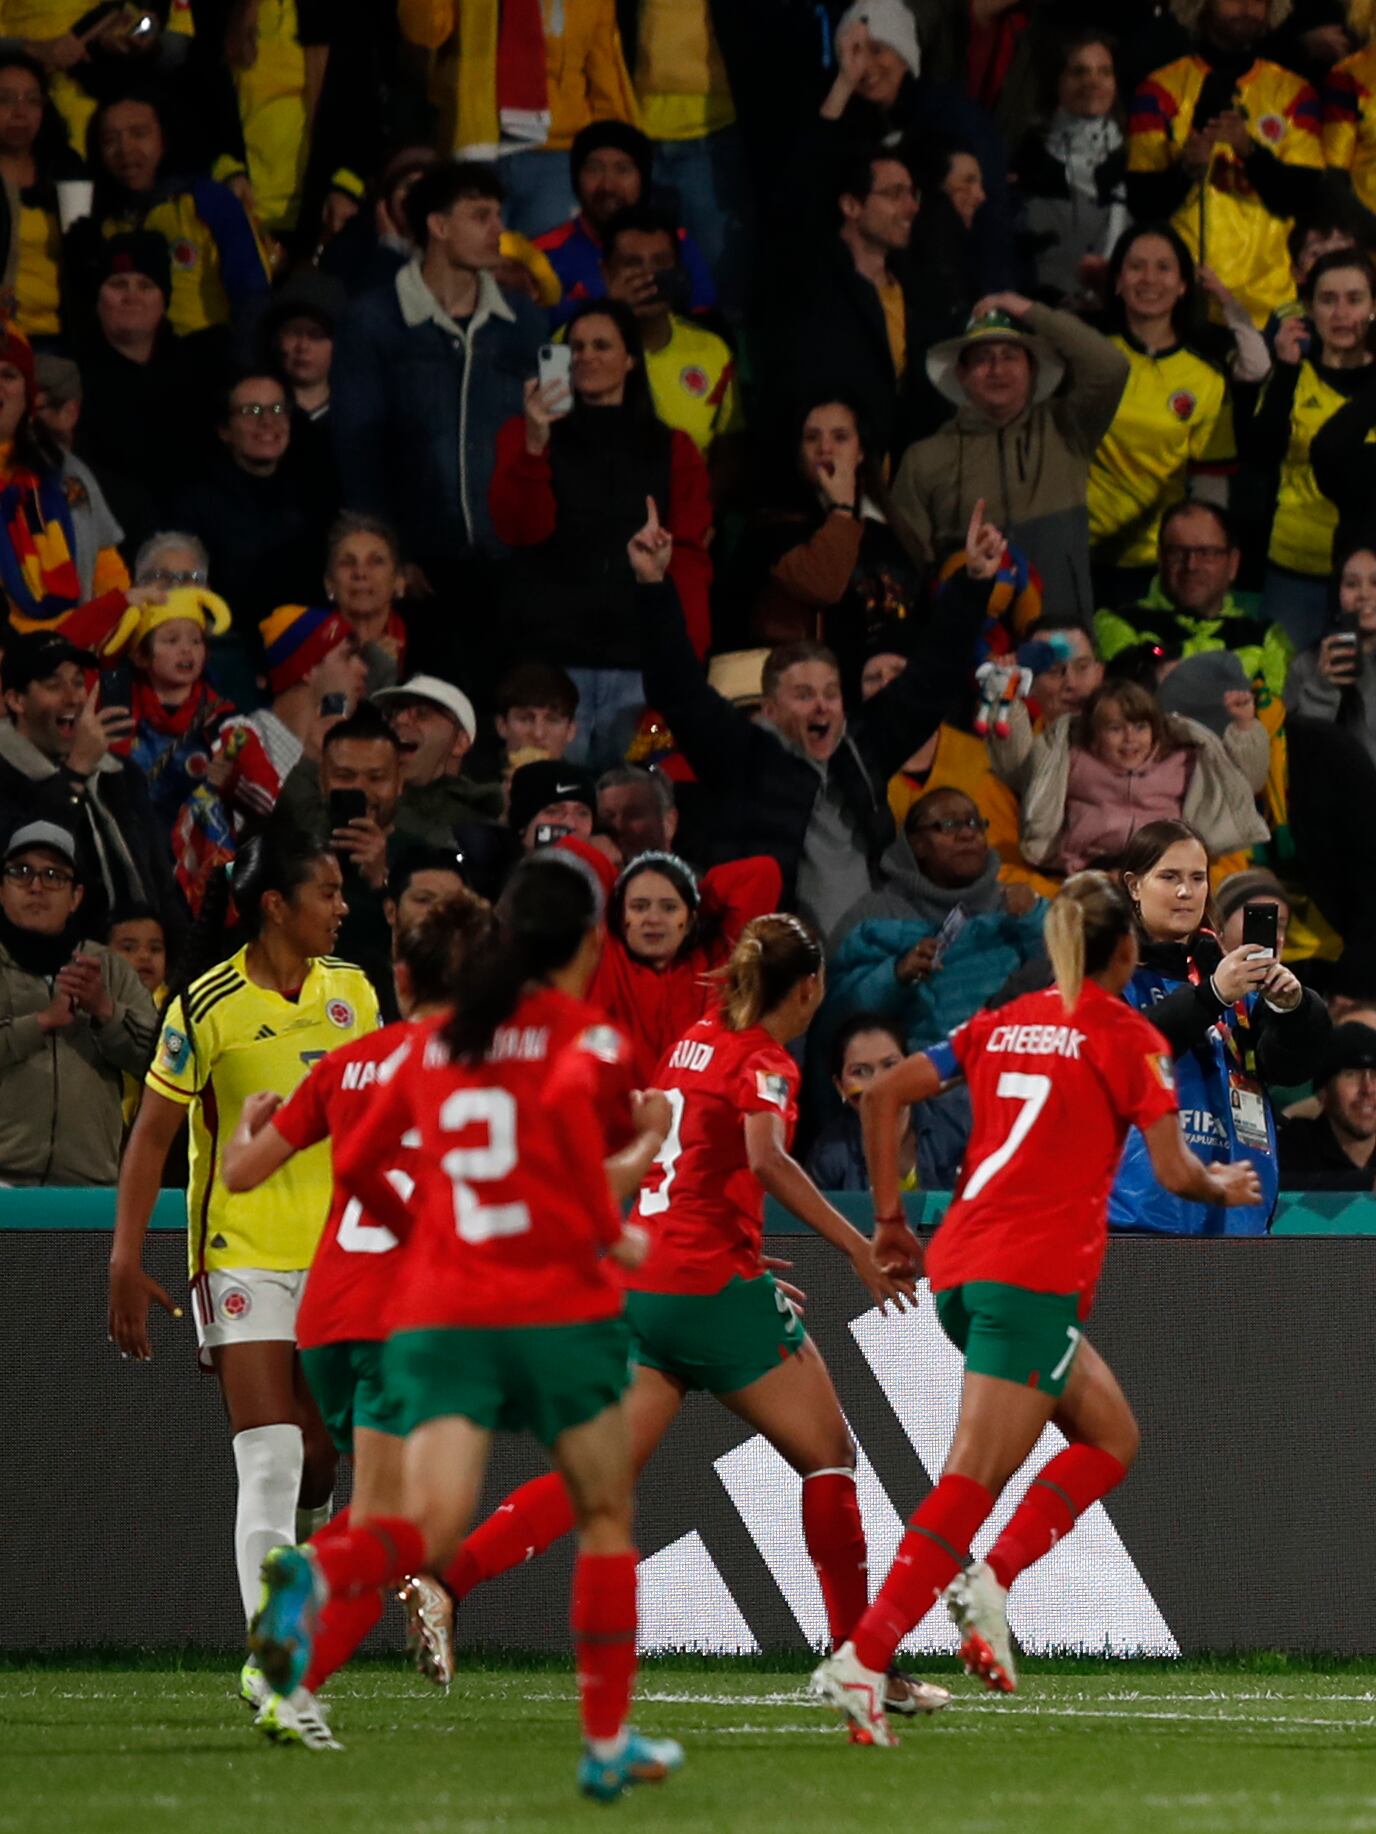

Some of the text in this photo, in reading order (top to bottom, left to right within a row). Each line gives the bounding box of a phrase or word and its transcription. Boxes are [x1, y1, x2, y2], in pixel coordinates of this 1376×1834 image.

[986, 1024, 1088, 1060] CHEEBAK
[961, 1071, 1052, 1201] 7
[1179, 1109, 1228, 1138] FIFA
[440, 1087, 531, 1246] 2
[1050, 1325, 1080, 1381] 7
